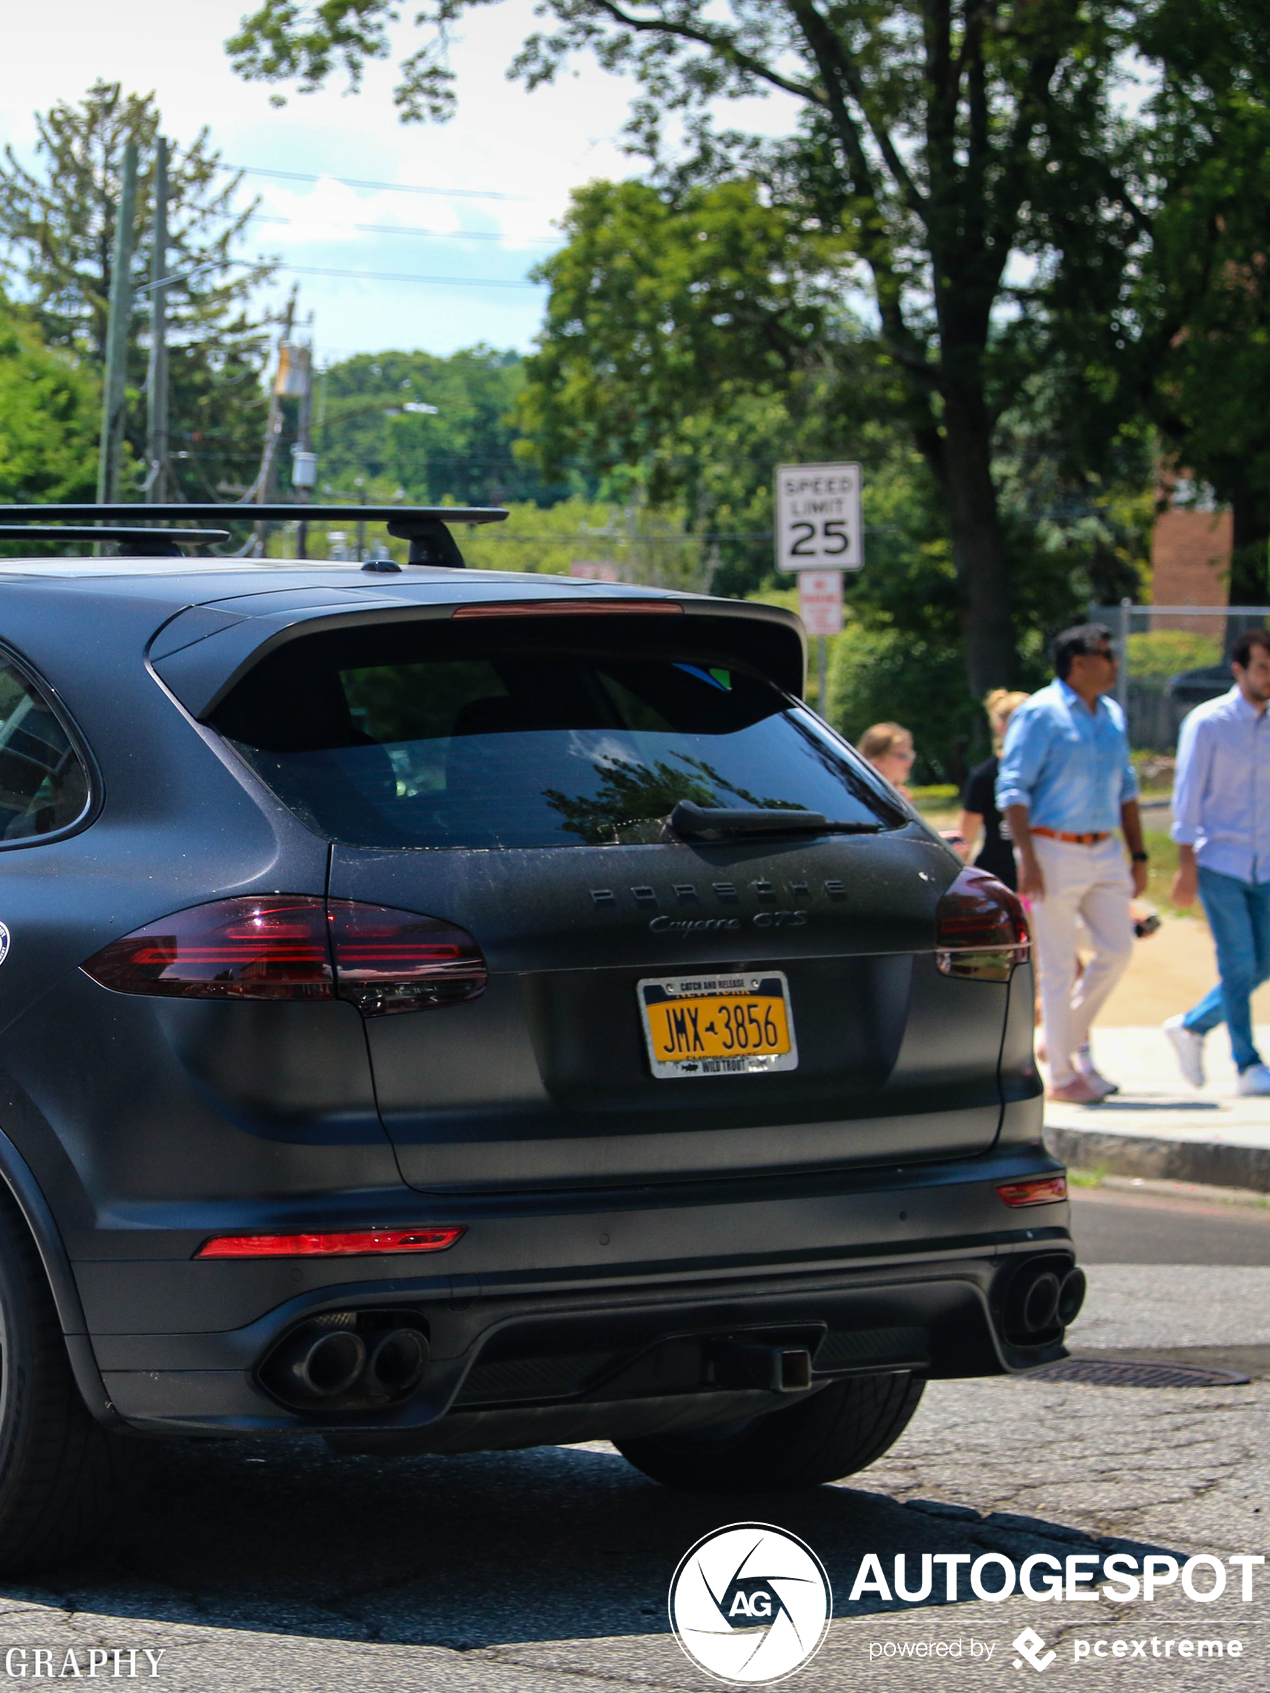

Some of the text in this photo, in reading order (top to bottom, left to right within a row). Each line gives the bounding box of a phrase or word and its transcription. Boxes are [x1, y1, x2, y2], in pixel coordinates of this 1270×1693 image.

[785, 476, 853, 495] SPEED
[791, 499, 844, 517] LIMIT
[790, 521, 850, 555] 25
[590, 880, 846, 904] PORSCHE
[649, 910, 808, 938] Cayenne GTS
[680, 979, 745, 991] CATCH AND RELEASE
[663, 1004, 778, 1053] JMX 3856
[702, 1059, 745, 1073] WILD TROUT
